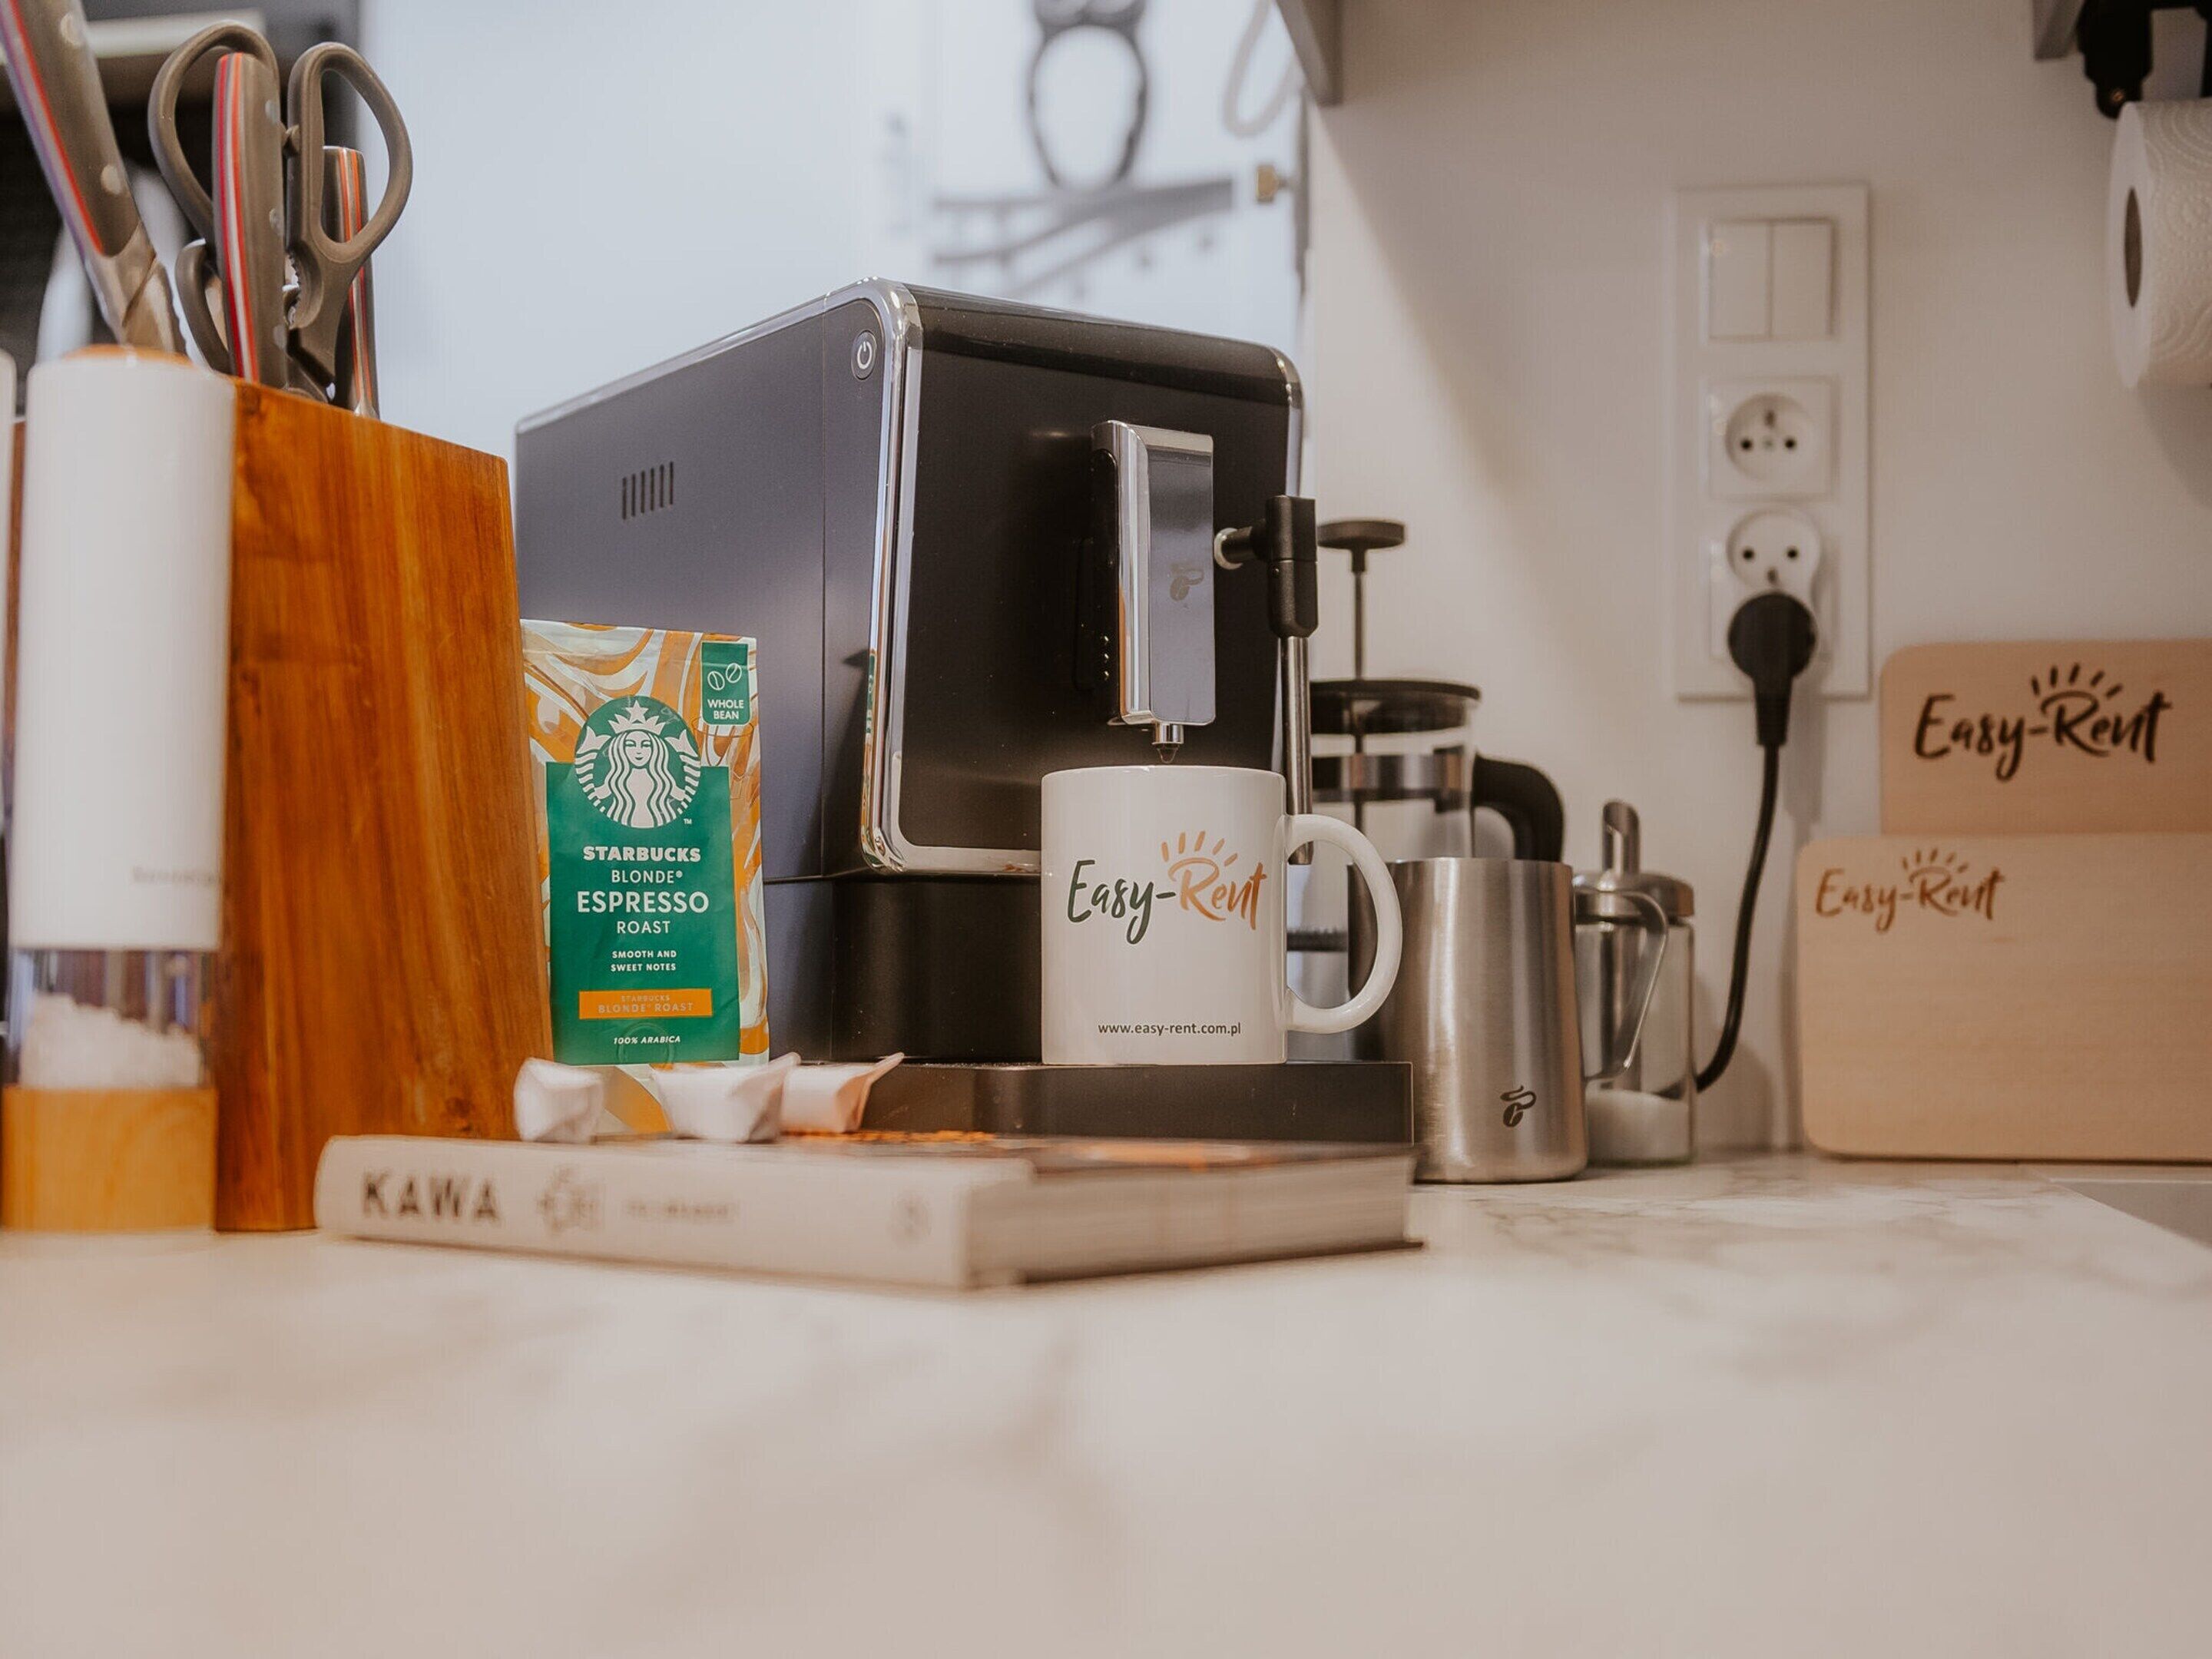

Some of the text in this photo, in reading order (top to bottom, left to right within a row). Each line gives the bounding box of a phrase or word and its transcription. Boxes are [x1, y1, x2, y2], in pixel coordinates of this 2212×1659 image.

[707, 699, 744, 708] WHOLE
[714, 710, 740, 719] BEAN
[1914, 690, 2173, 782] Easy-Rent
[582, 846, 702, 863] STARBUCKS
[577, 890, 710, 913] ESPRESSO
[1068, 856, 1267, 945] Easy-Rent
[1815, 866, 2006, 933] Easy-Rent
[617, 921, 671, 934] ROAST
[611, 950, 654, 959] SMOOTH
[611, 963, 676, 972] SWEET NOTES
[654, 1002, 694, 1012] ROAST
[1098, 1022, 1242, 1035] www.easy-rent.com.pl
[640, 1035, 681, 1044] ARABICA
[363, 1169, 502, 1221] KAWA
